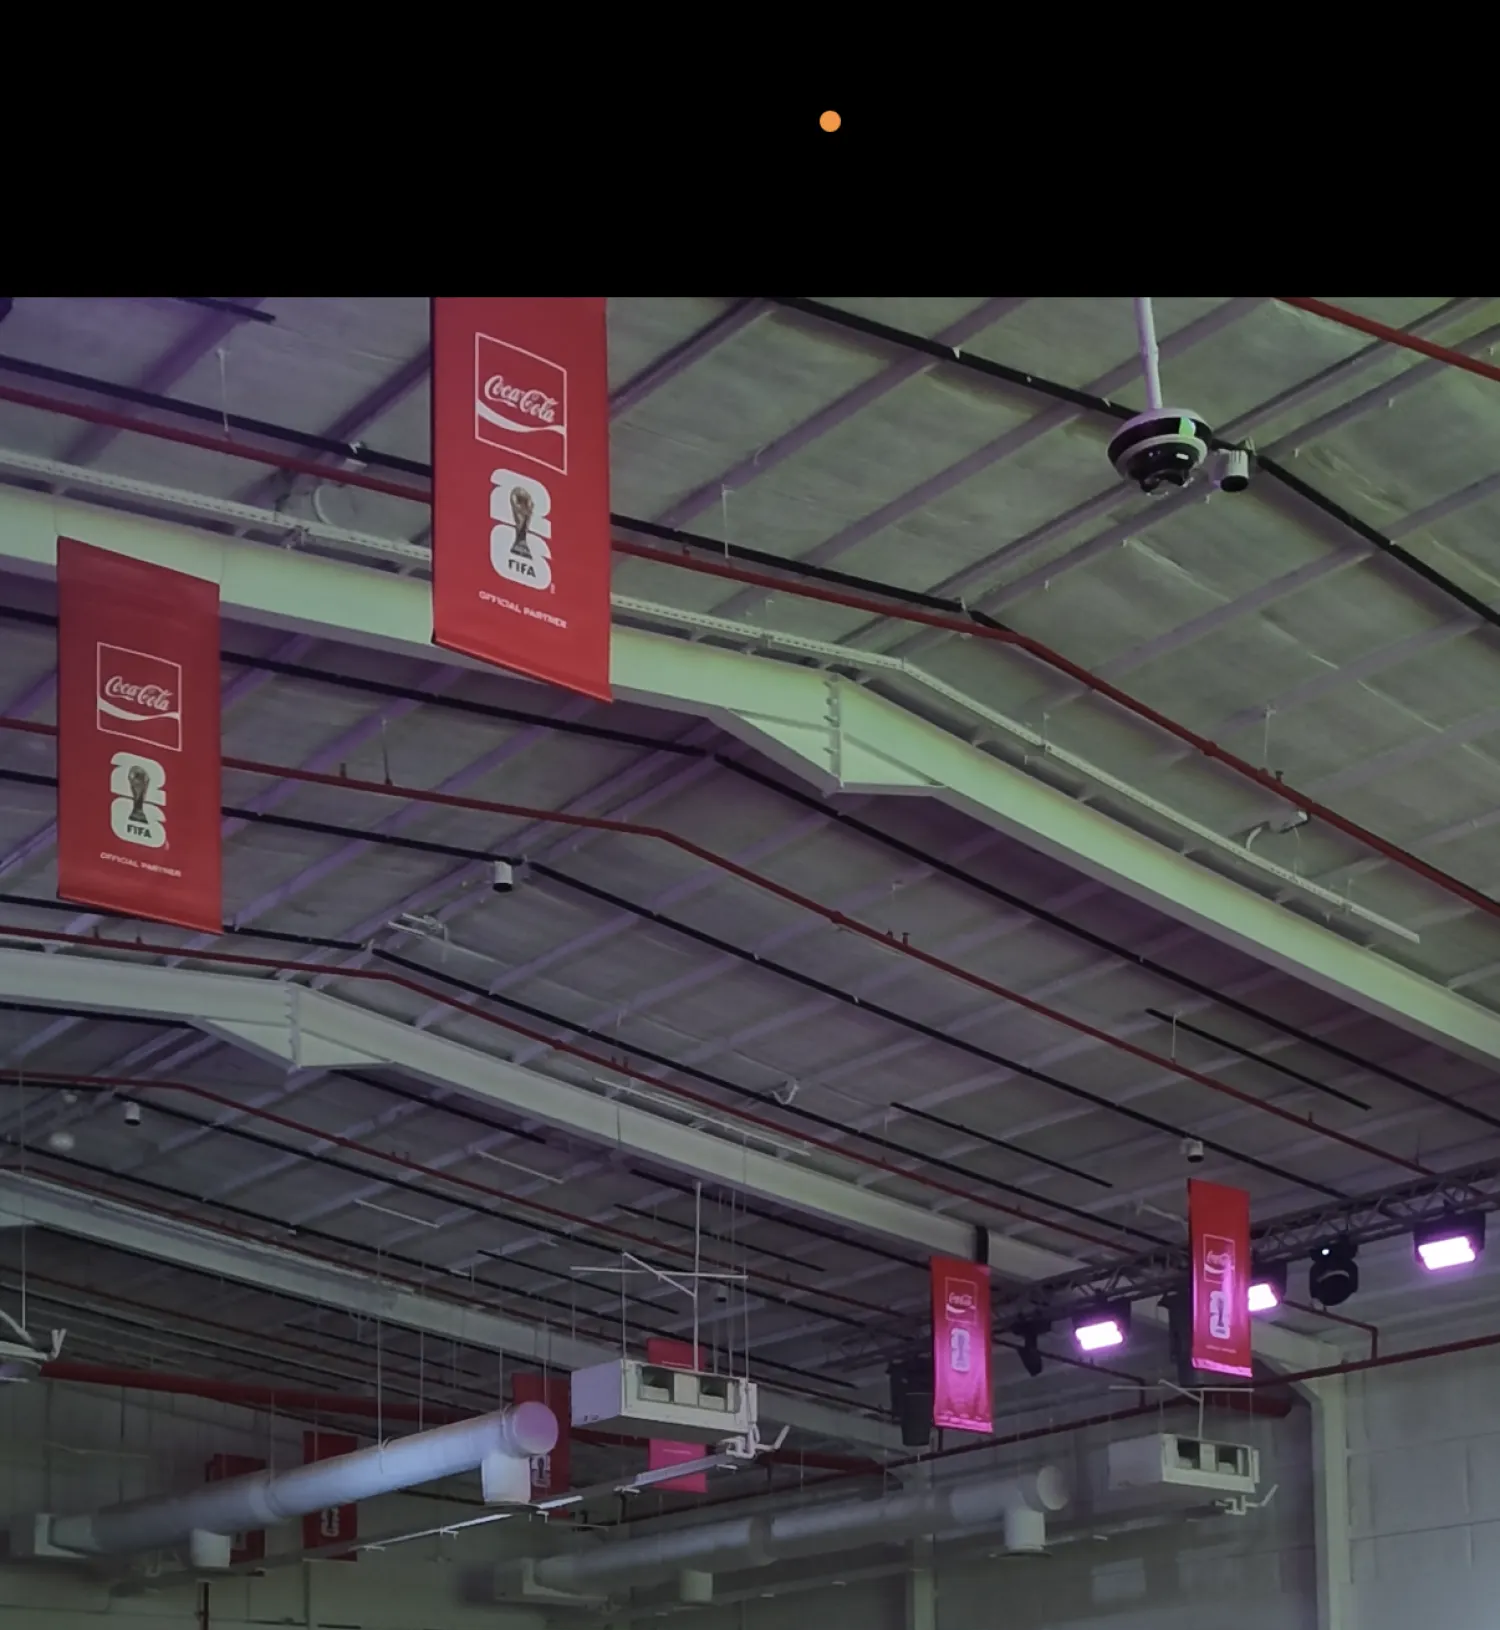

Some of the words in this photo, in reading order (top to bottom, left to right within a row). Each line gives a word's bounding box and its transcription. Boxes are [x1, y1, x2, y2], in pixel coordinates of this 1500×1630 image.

[484, 375, 559, 423] Coca-Cola
[508, 558, 537, 578] FIFA
[479, 591, 522, 614] OFFICIAL
[523, 606, 567, 629] PARTNER
[105, 675, 173, 711] Coca-Cola
[127, 824, 152, 839] FIFA
[100, 851, 139, 868] OFFICIAL
[140, 861, 182, 877] PARTNER
